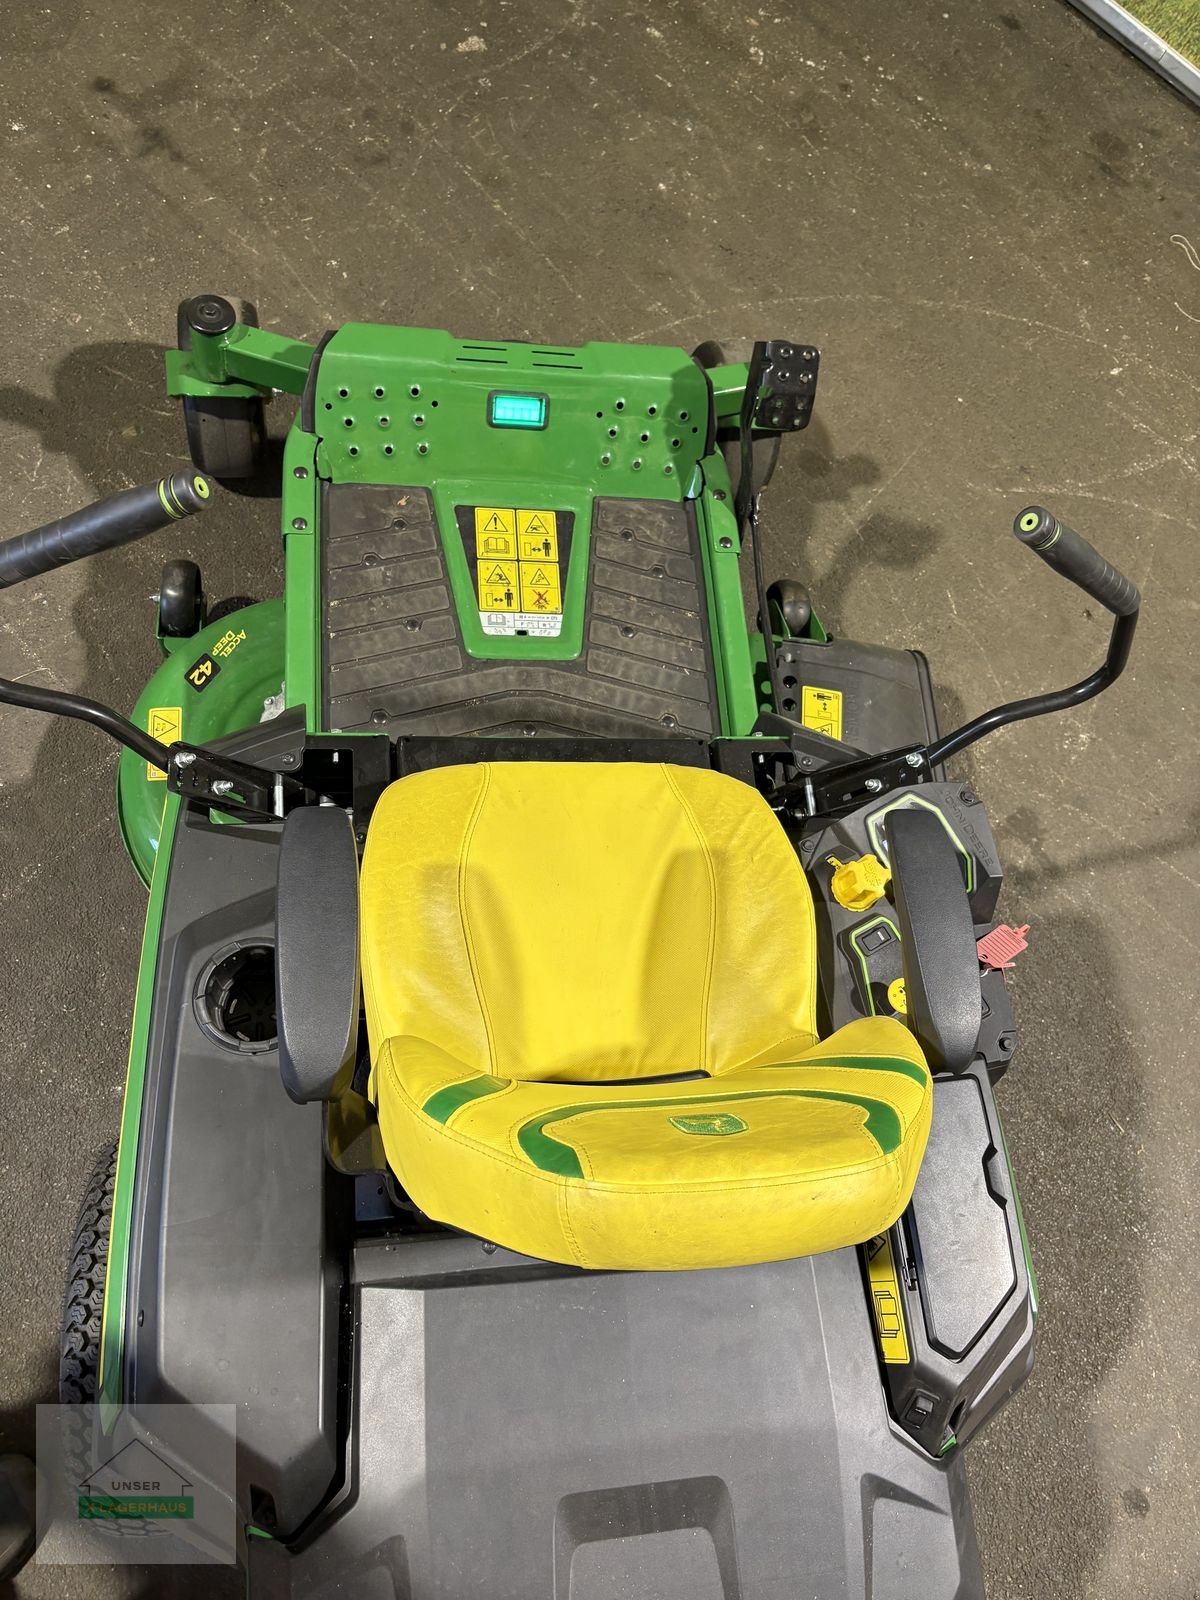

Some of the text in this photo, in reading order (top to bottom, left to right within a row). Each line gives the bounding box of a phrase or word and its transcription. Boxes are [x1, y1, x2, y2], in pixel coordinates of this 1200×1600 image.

[212, 630, 236, 656] DEEP
[219, 629, 247, 657] ACCEL
[189, 660, 212, 686] 42
[963, 823, 994, 867] DEERE
